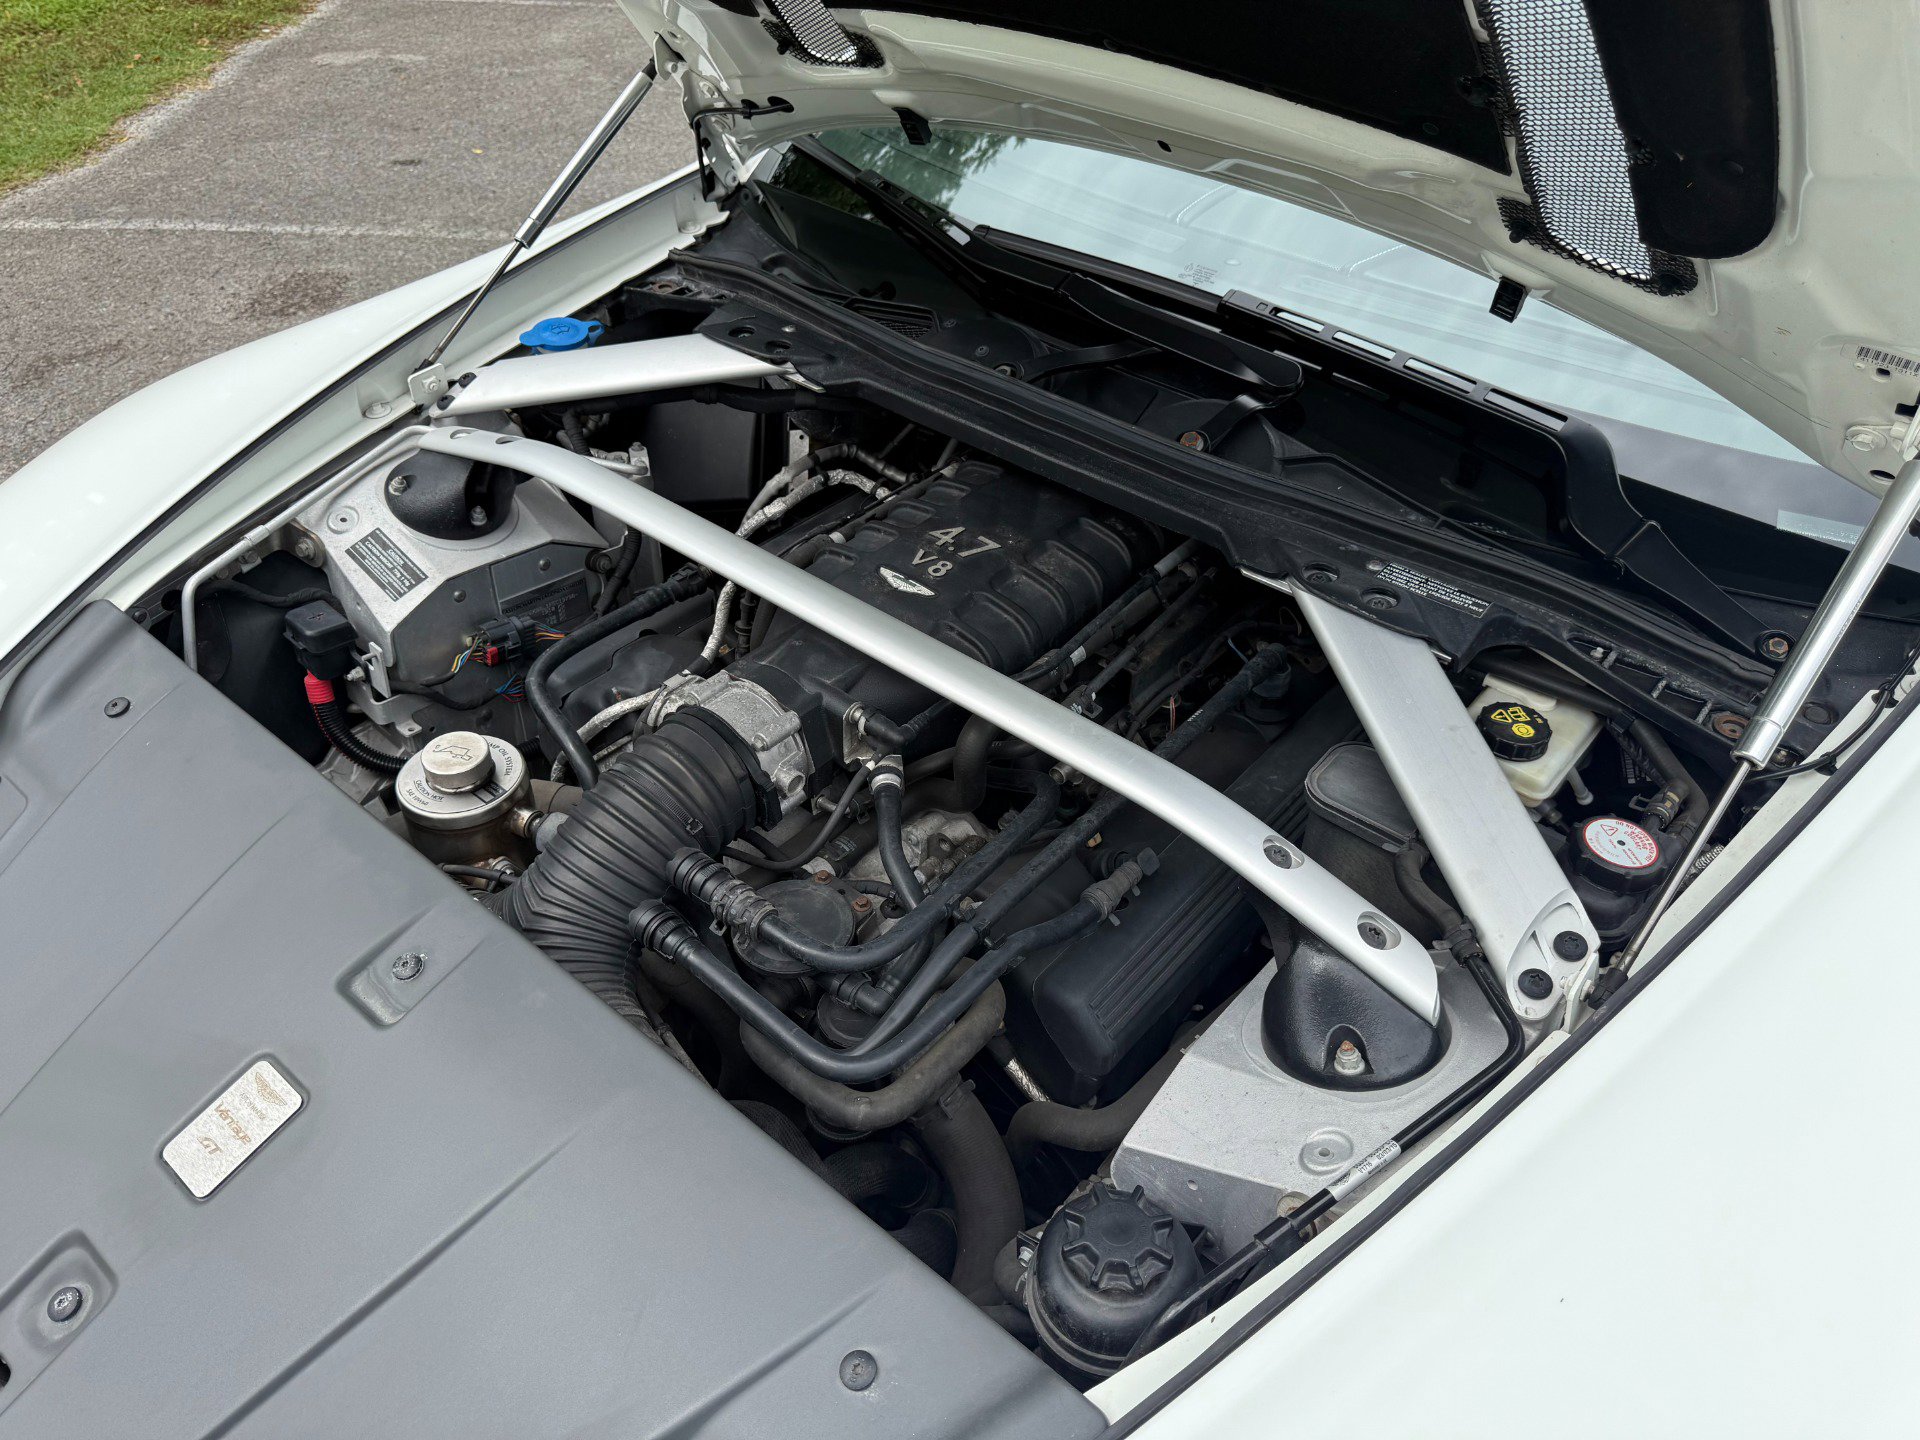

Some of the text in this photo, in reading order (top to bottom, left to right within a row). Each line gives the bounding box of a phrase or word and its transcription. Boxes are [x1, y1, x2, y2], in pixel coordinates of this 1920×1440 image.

[928, 526, 1002, 558] 4.7
[912, 548, 953, 577] V8
[1418, 582, 1437, 591] AVANT
[1428, 590, 1451, 600] LIQUIDE
[1460, 594, 1490, 606] BOUCHON
[498, 748, 509, 757] OIL
[504, 756, 514, 776] SYSTEM
[416, 780, 430, 796] CAUTION
[214, 1100, 252, 1145] Vantage
[197, 1135, 223, 1155] GT
